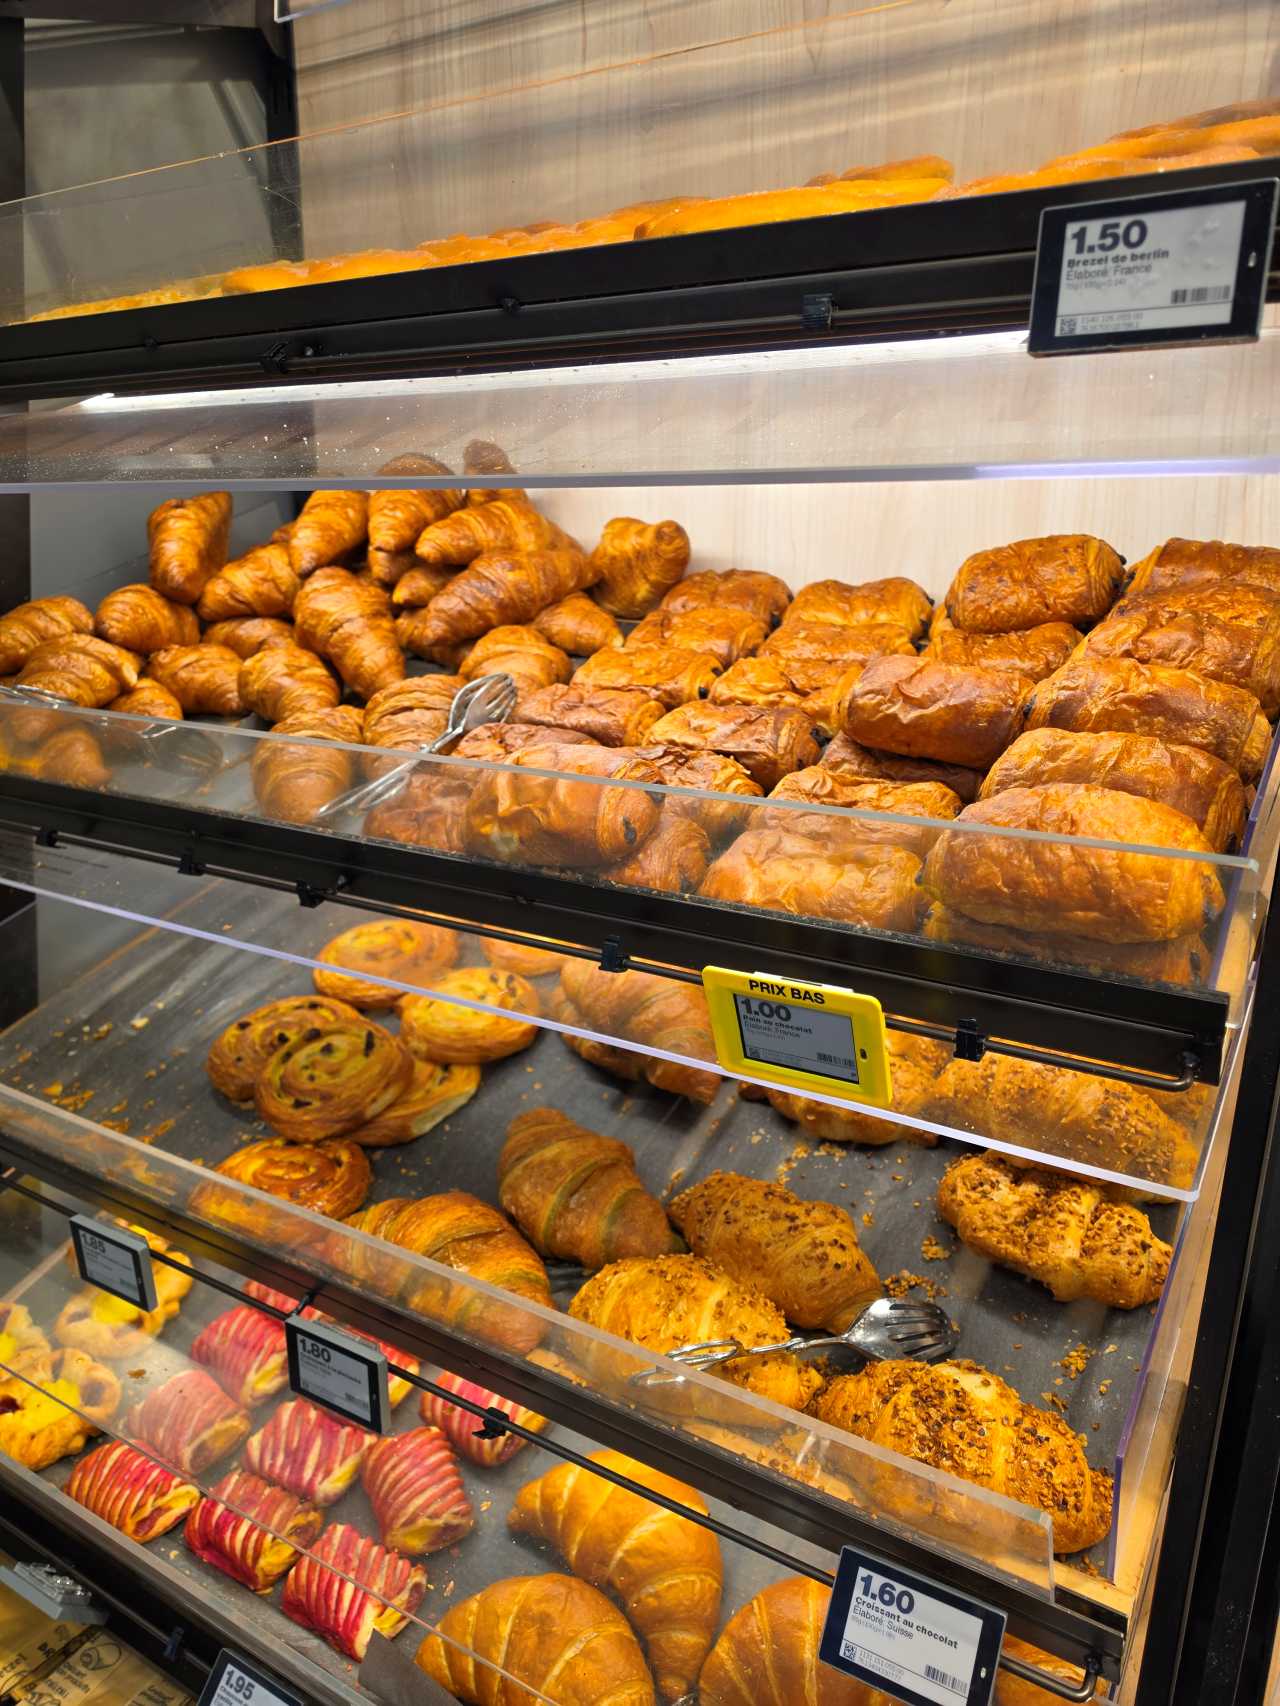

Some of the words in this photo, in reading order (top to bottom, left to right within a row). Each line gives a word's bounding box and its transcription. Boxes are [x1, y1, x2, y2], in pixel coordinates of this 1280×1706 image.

[1071, 219, 1148, 255] 1.50
[1067, 255, 1108, 268] Brezel
[1112, 254, 1127, 264] de
[1130, 248, 1169, 262] berlin
[1112, 264, 1153, 277] France
[749, 979, 786, 997] PRIX
[790, 987, 825, 1005] BAS
[741, 998, 792, 1022] 1.00
[299, 1338, 332, 1363] 1.80
[860, 1574, 915, 1615] 1.60
[856, 1596, 900, 1622] Croissant
[902, 1619, 914, 1629] au
[916, 1624, 958, 1650] chocolat
[887, 1620, 914, 1640] Suisse
[225, 1669, 255, 1700] 1.95
